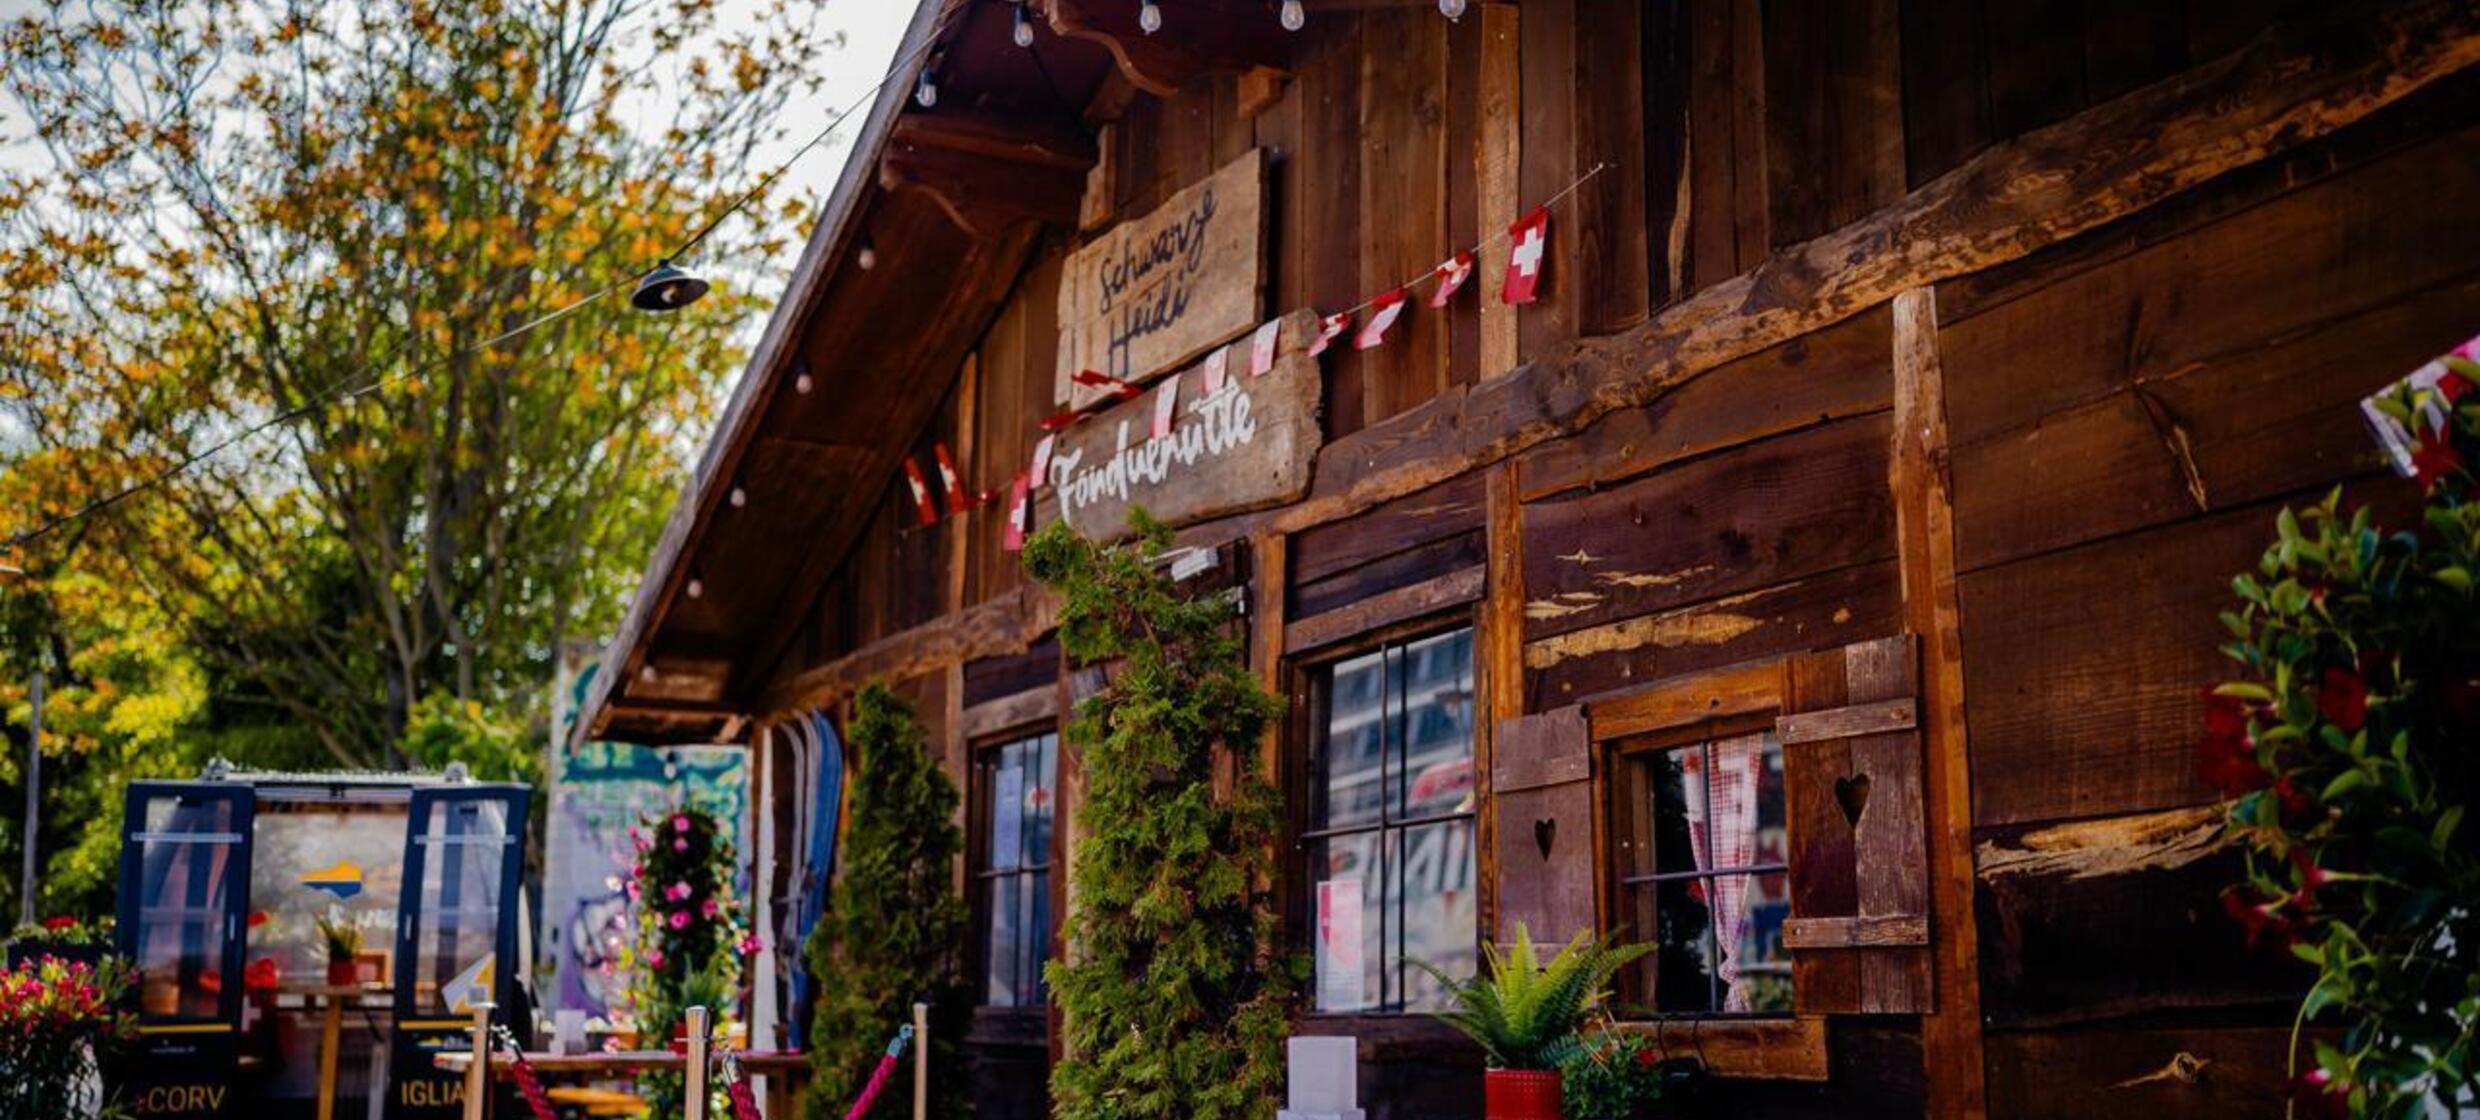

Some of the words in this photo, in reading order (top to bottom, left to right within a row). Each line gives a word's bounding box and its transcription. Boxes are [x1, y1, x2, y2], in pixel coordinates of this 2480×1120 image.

[1101, 189, 1217, 313] Schwarze
[1108, 268, 1191, 378] Heidi
[147, 1085, 227, 1112] CORV
